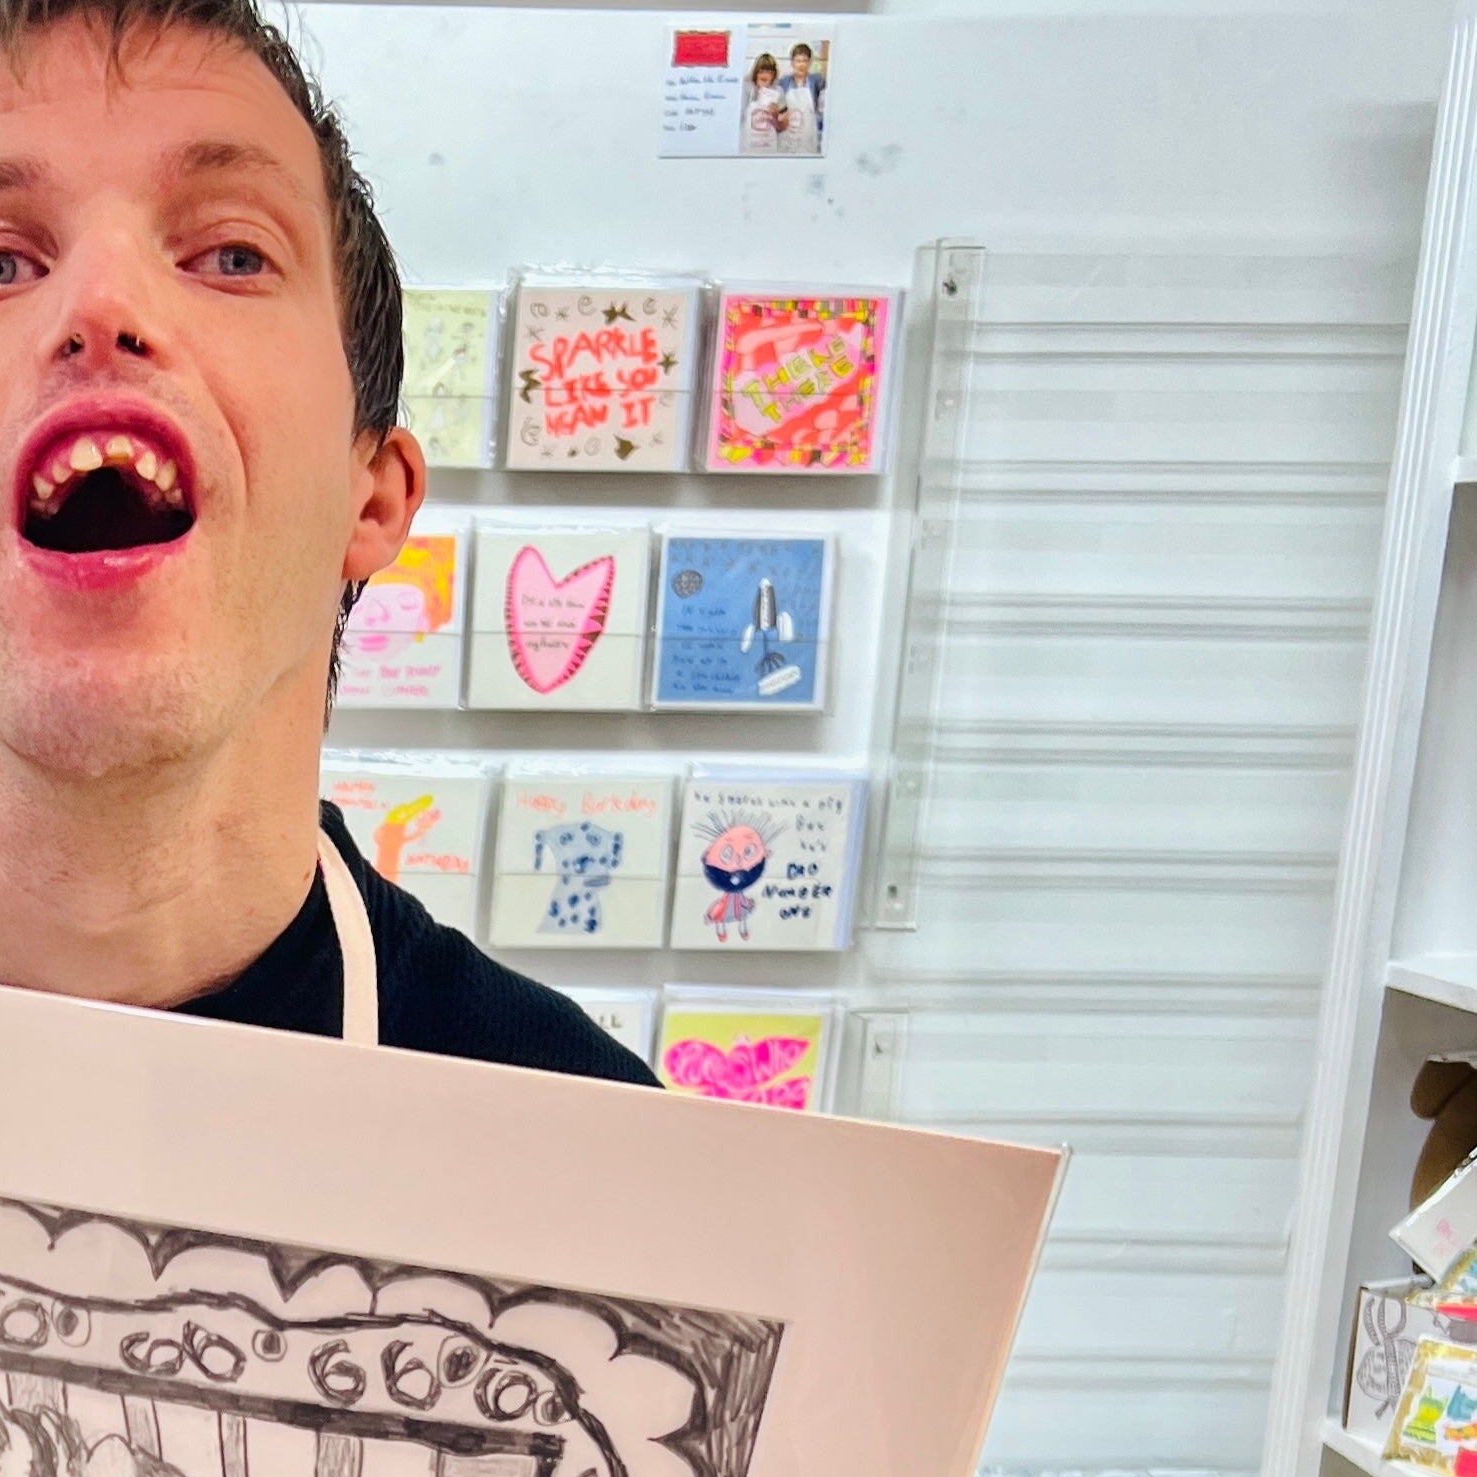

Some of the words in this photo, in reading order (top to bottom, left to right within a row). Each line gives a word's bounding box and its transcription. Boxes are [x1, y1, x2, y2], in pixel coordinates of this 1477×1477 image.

[529, 328, 658, 382] SPARKLE
[544, 371, 613, 406] LIKE
[615, 367, 657, 399] YOU
[620, 396, 655, 428] IT
